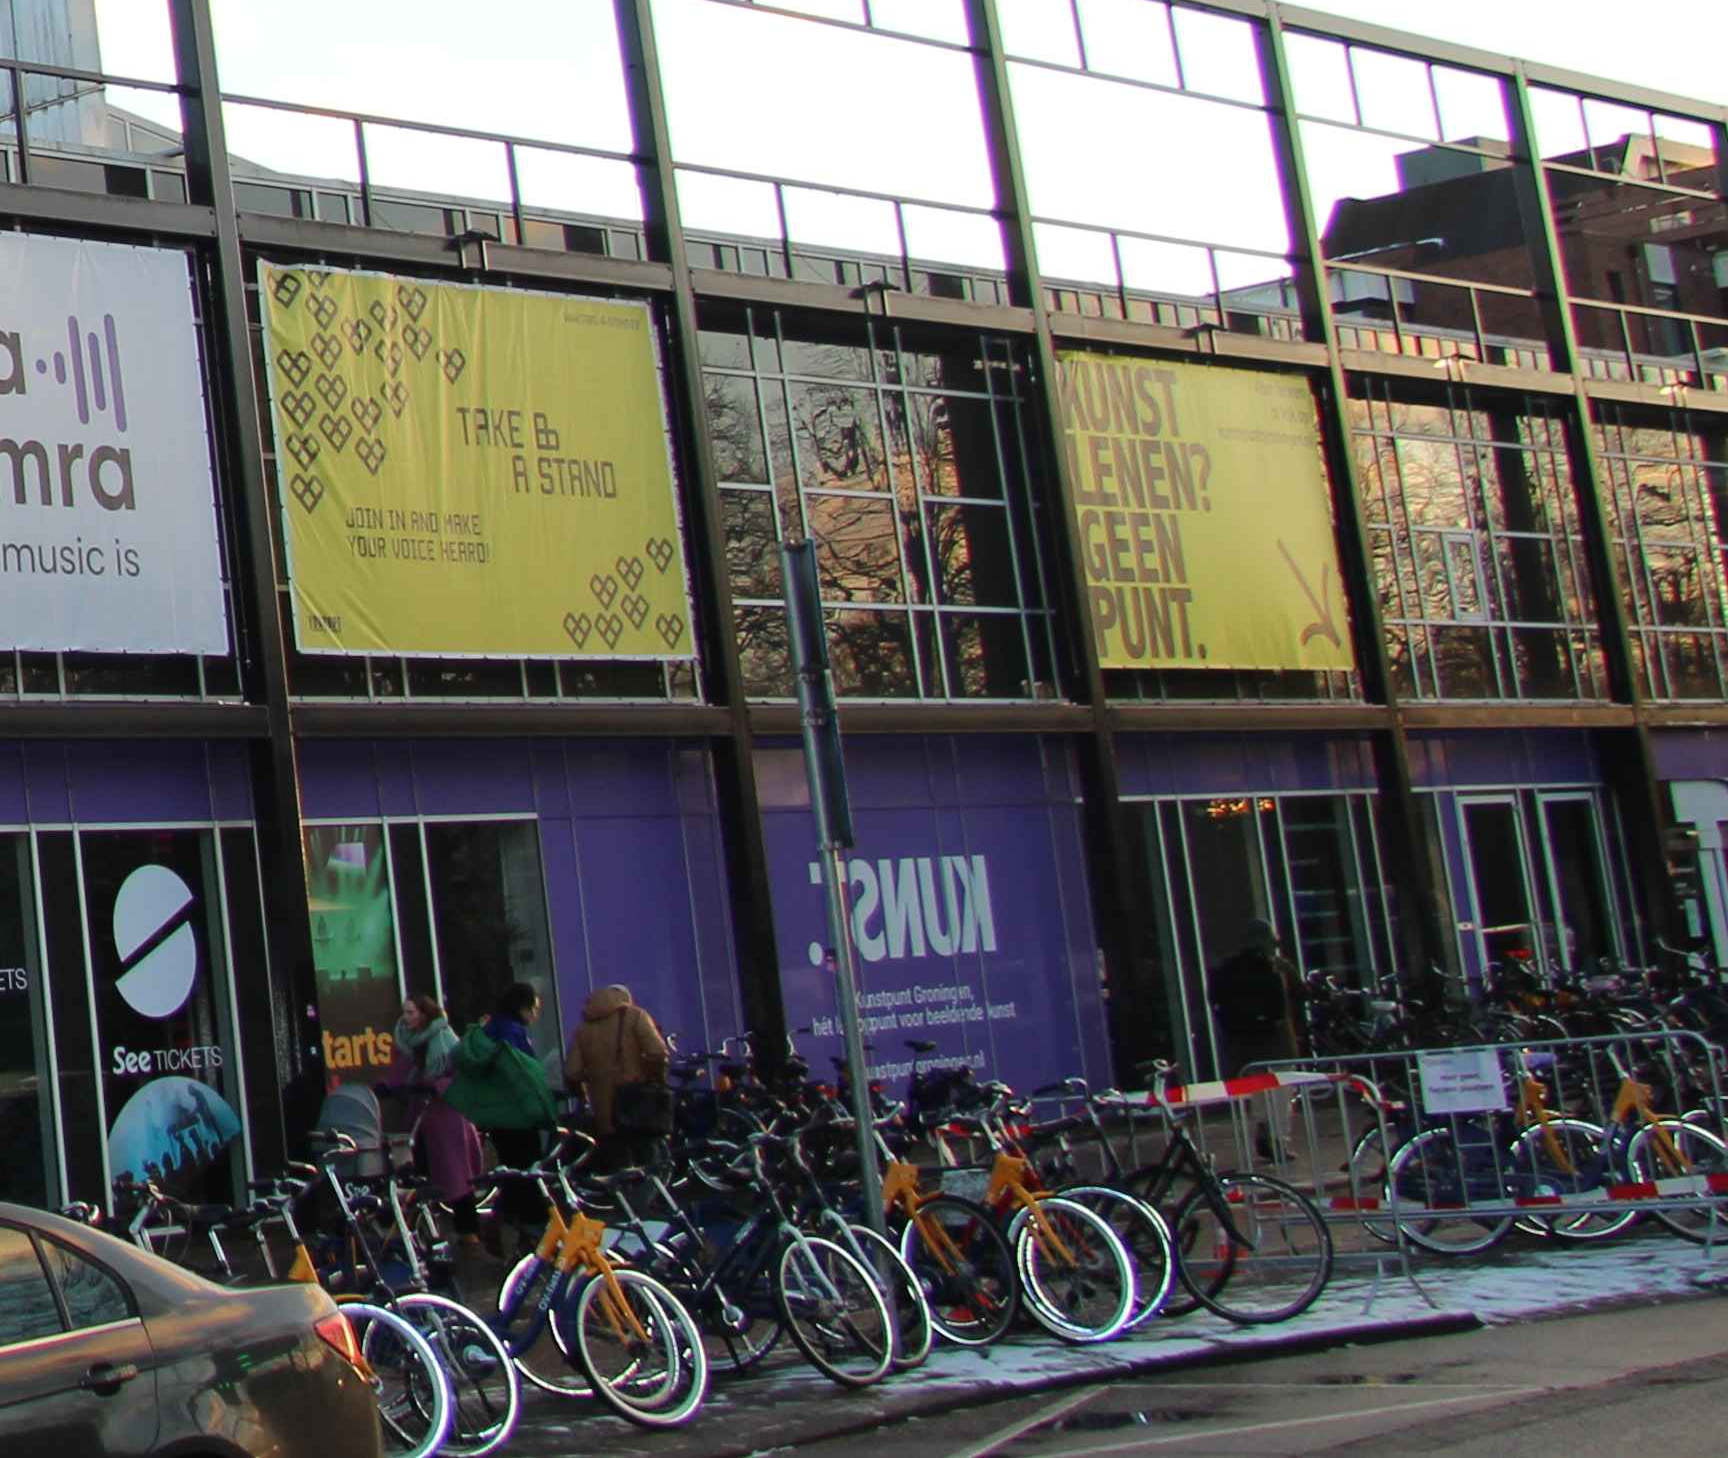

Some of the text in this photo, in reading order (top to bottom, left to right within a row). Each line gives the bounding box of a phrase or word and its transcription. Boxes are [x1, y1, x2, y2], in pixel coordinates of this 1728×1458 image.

[1056, 358, 1180, 437] KUNST
[456, 407, 524, 448] TAKE
[512, 455, 617, 499] A STAND
[1065, 437, 1211, 512] LENEN?
[346, 507, 481, 535] JOIN IN AND MAKE
[2, 537, 104, 576] music
[115, 539, 140, 578] is
[346, 536, 490, 563] YOUR VOICE HEARD!
[1080, 509, 1186, 584] GEEN
[1089, 585, 1207, 661] PUNT.
[899, 1012, 923, 1027] voor
[112, 1045, 223, 1075] See TICKETS
[322, 1027, 393, 1071] tarts
